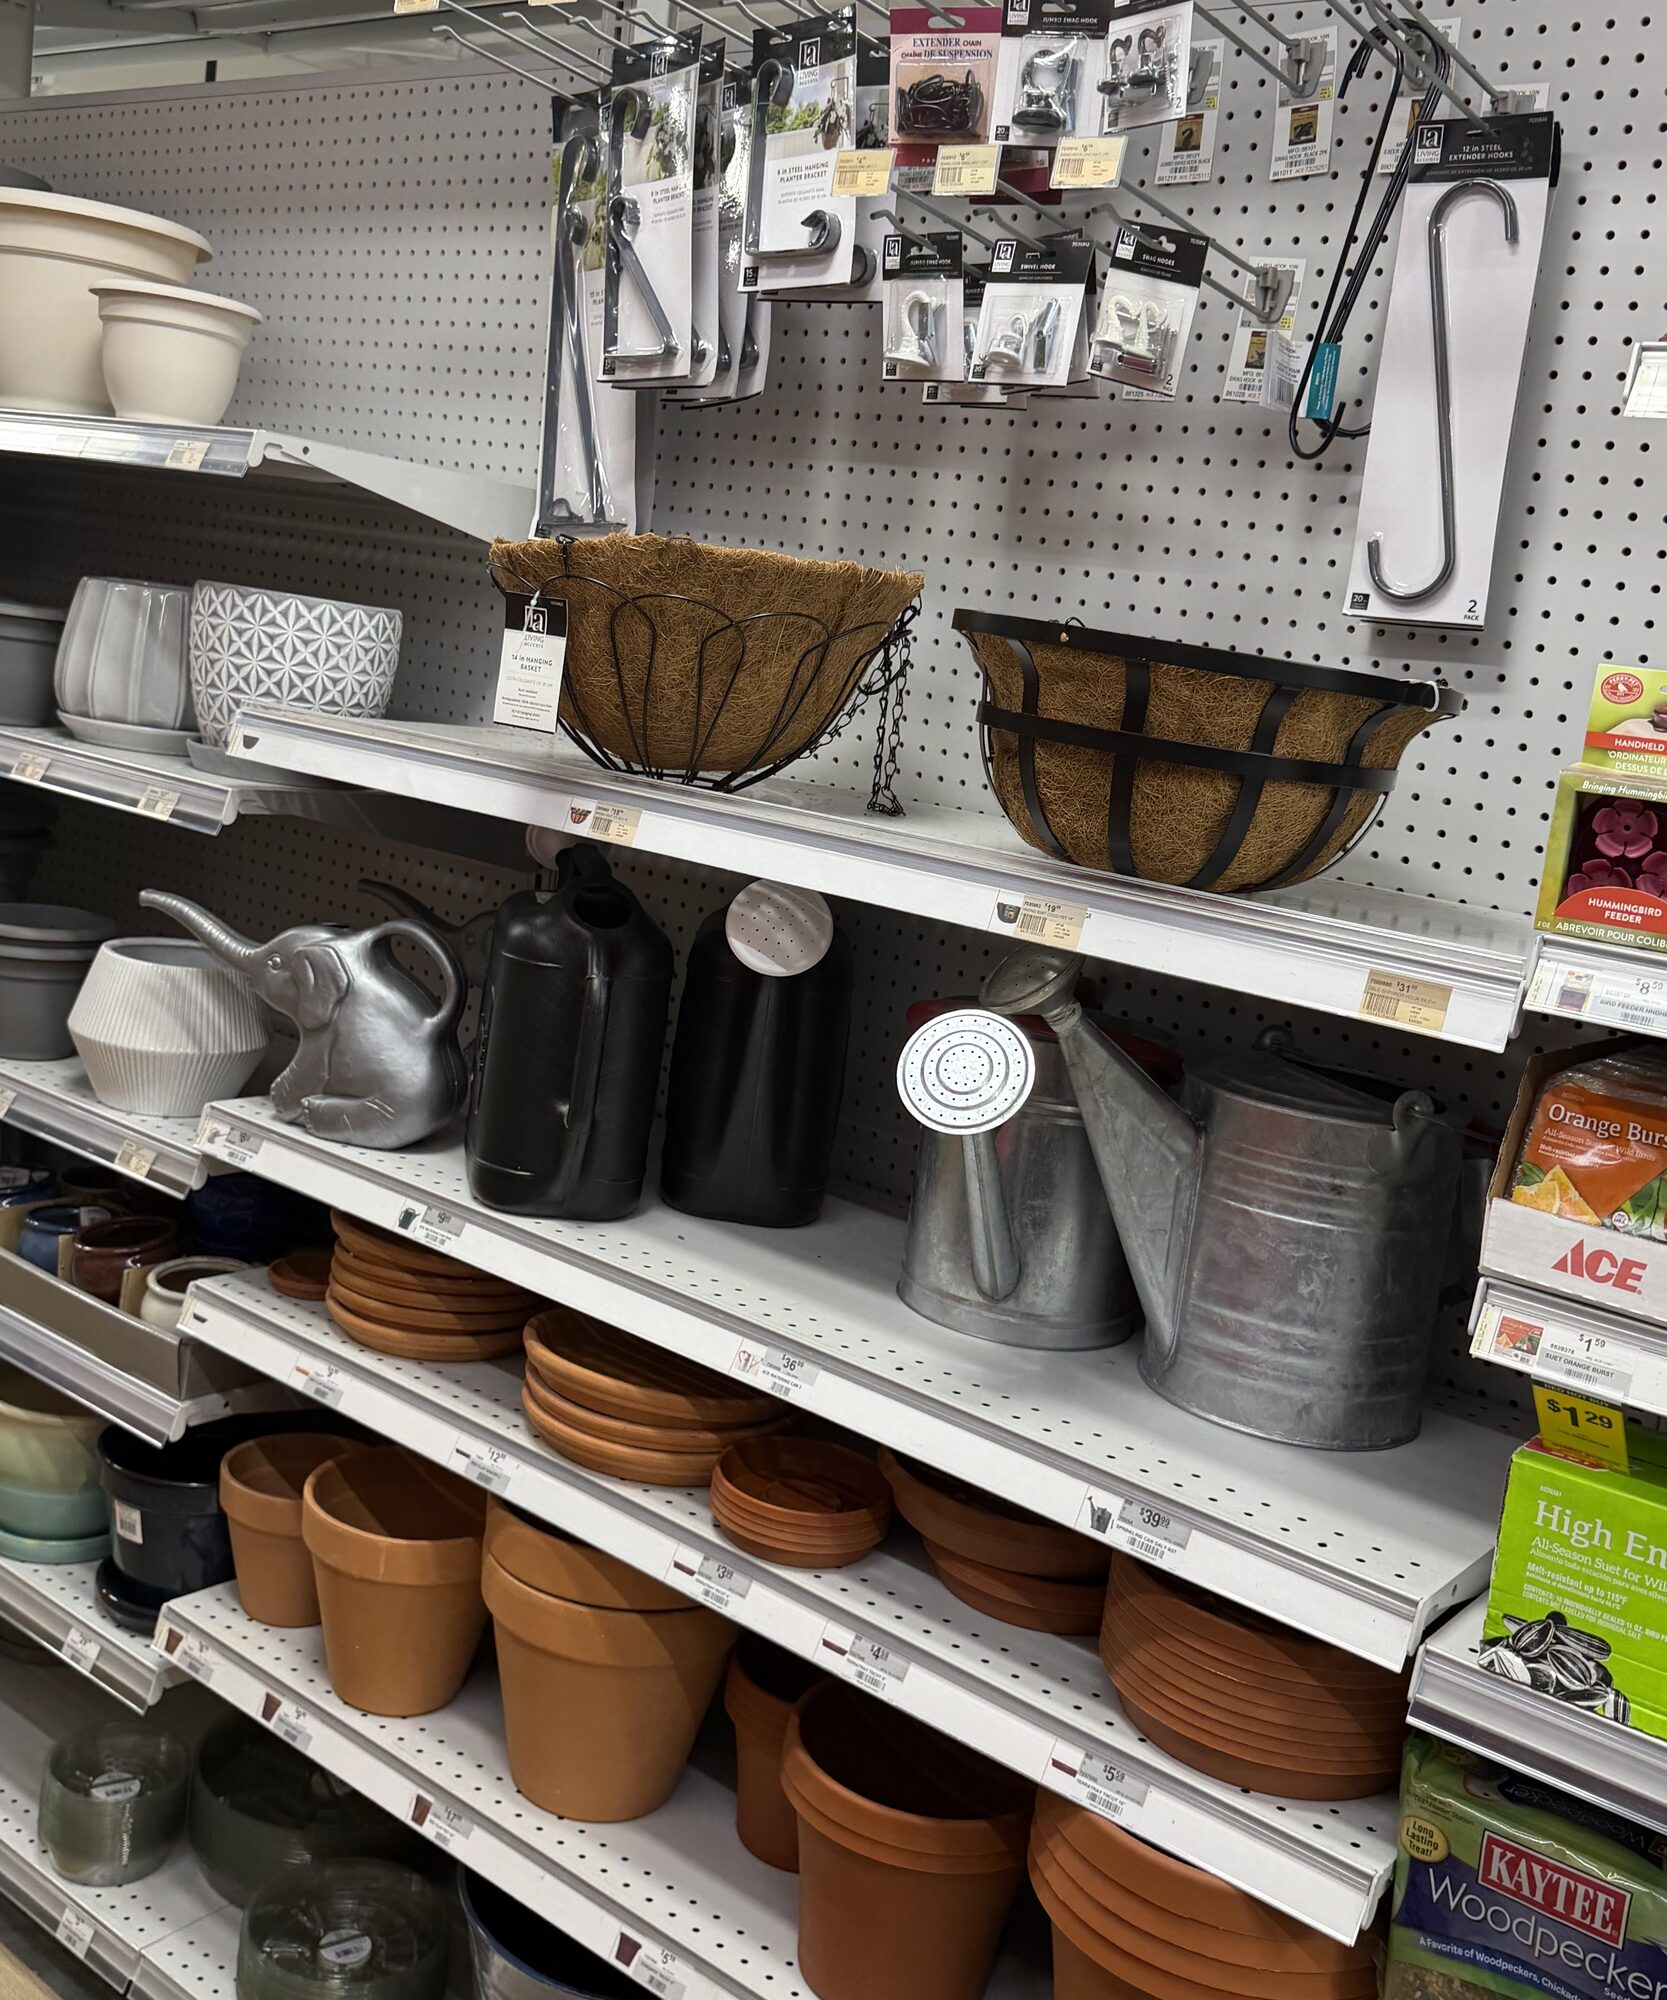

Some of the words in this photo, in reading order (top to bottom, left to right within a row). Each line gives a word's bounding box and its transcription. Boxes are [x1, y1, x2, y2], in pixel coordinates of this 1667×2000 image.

[912, 37, 961, 48] EXTENDER
[962, 39, 982, 47] CHAIN
[937, 50, 993, 59] SUSPENSION
[1175, 96, 1182, 109] 2
[996, 127, 1005, 135] 20
[1416, 149, 1440, 157] LIVING
[1449, 152, 1486, 161] EXTENDER
[1487, 151, 1514, 159] HOOKS
[788, 165, 804, 174] STEEL
[804, 161, 829, 172] HANGING
[780, 174, 803, 183] PLANTER
[804, 170, 827, 180] BRACKET
[1142, 254, 1156, 262] SWAG
[1156, 257, 1175, 267] HOOKS
[1165, 374, 1174, 385] 2
[1353, 594, 1364, 602] 20
[1467, 599, 1478, 613] 2
[525, 634, 545, 643] LIVING
[520, 664, 542, 673] BASKET
[526, 657, 553, 667] HANGING
[1614, 738, 1665, 752] HANDHELD
[1615, 761, 1649, 773] DESSUS
[1650, 766, 1661, 775] DE
[1582, 780, 1616, 795] Bringing
[1587, 897, 1663, 917] HUMMINGBIRD
[1604, 910, 1642, 925] FEEDER
[1555, 922, 1605, 938] ABREVOIR
[1606, 930, 1634, 943] POUR
[1600, 999, 1617, 1007] BIRD
[1618, 1001, 1646, 1013] FEEDER
[1548, 1103, 1621, 1139] Orange
[1544, 1128, 1585, 1144] All-Season
[1616, 1145, 1633, 1157] Wild
[1635, 1151, 1656, 1162] Birds
[1551, 1238, 1648, 1293] ACE
[1545, 1352, 1563, 1363] SUET
[1563, 1358, 1591, 1372] ORANGE
[1591, 1366, 1615, 1378] BURST
[1116, 1523, 1143, 1540] SPRINKLING
[1143, 1534, 1154, 1545] CAN
[1534, 1500, 1612, 1551] High
[1623, 1530, 1667, 1570] En
[1529, 1548, 1564, 1566] Alimento
[1612, 1578, 1629, 1589] para
[1531, 1536, 1592, 1565] All-Season
[1594, 1557, 1621, 1576] Suet
[1623, 1568, 1641, 1583] for
[1644, 1574, 1667, 1593] Wil
[1527, 1562, 1582, 1589] Melt-resistant
[1583, 1582, 1595, 1594] up
[1596, 1586, 1605, 1597] to
[1549, 1600, 1560, 1610] NOT
[1560, 1604, 1585, 1619] LABELED
[1585, 1613, 1596, 1623] FOR
[1627, 1630, 1641, 1641] SALE
[1602, 1612, 1625, 1627] SEALED
[1412, 1820, 1434, 1838] Long
[1406, 1827, 1439, 1851] Lasting
[1408, 1839, 1433, 1857] Treat!
[1488, 1844, 1615, 1938] KAYTEE
[1419, 1936, 1427, 1945] A
[1426, 1937, 1464, 1955] Favorite
[1464, 1948, 1475, 1959] of
[1475, 1951, 1541, 1984] Woodpeckers,
